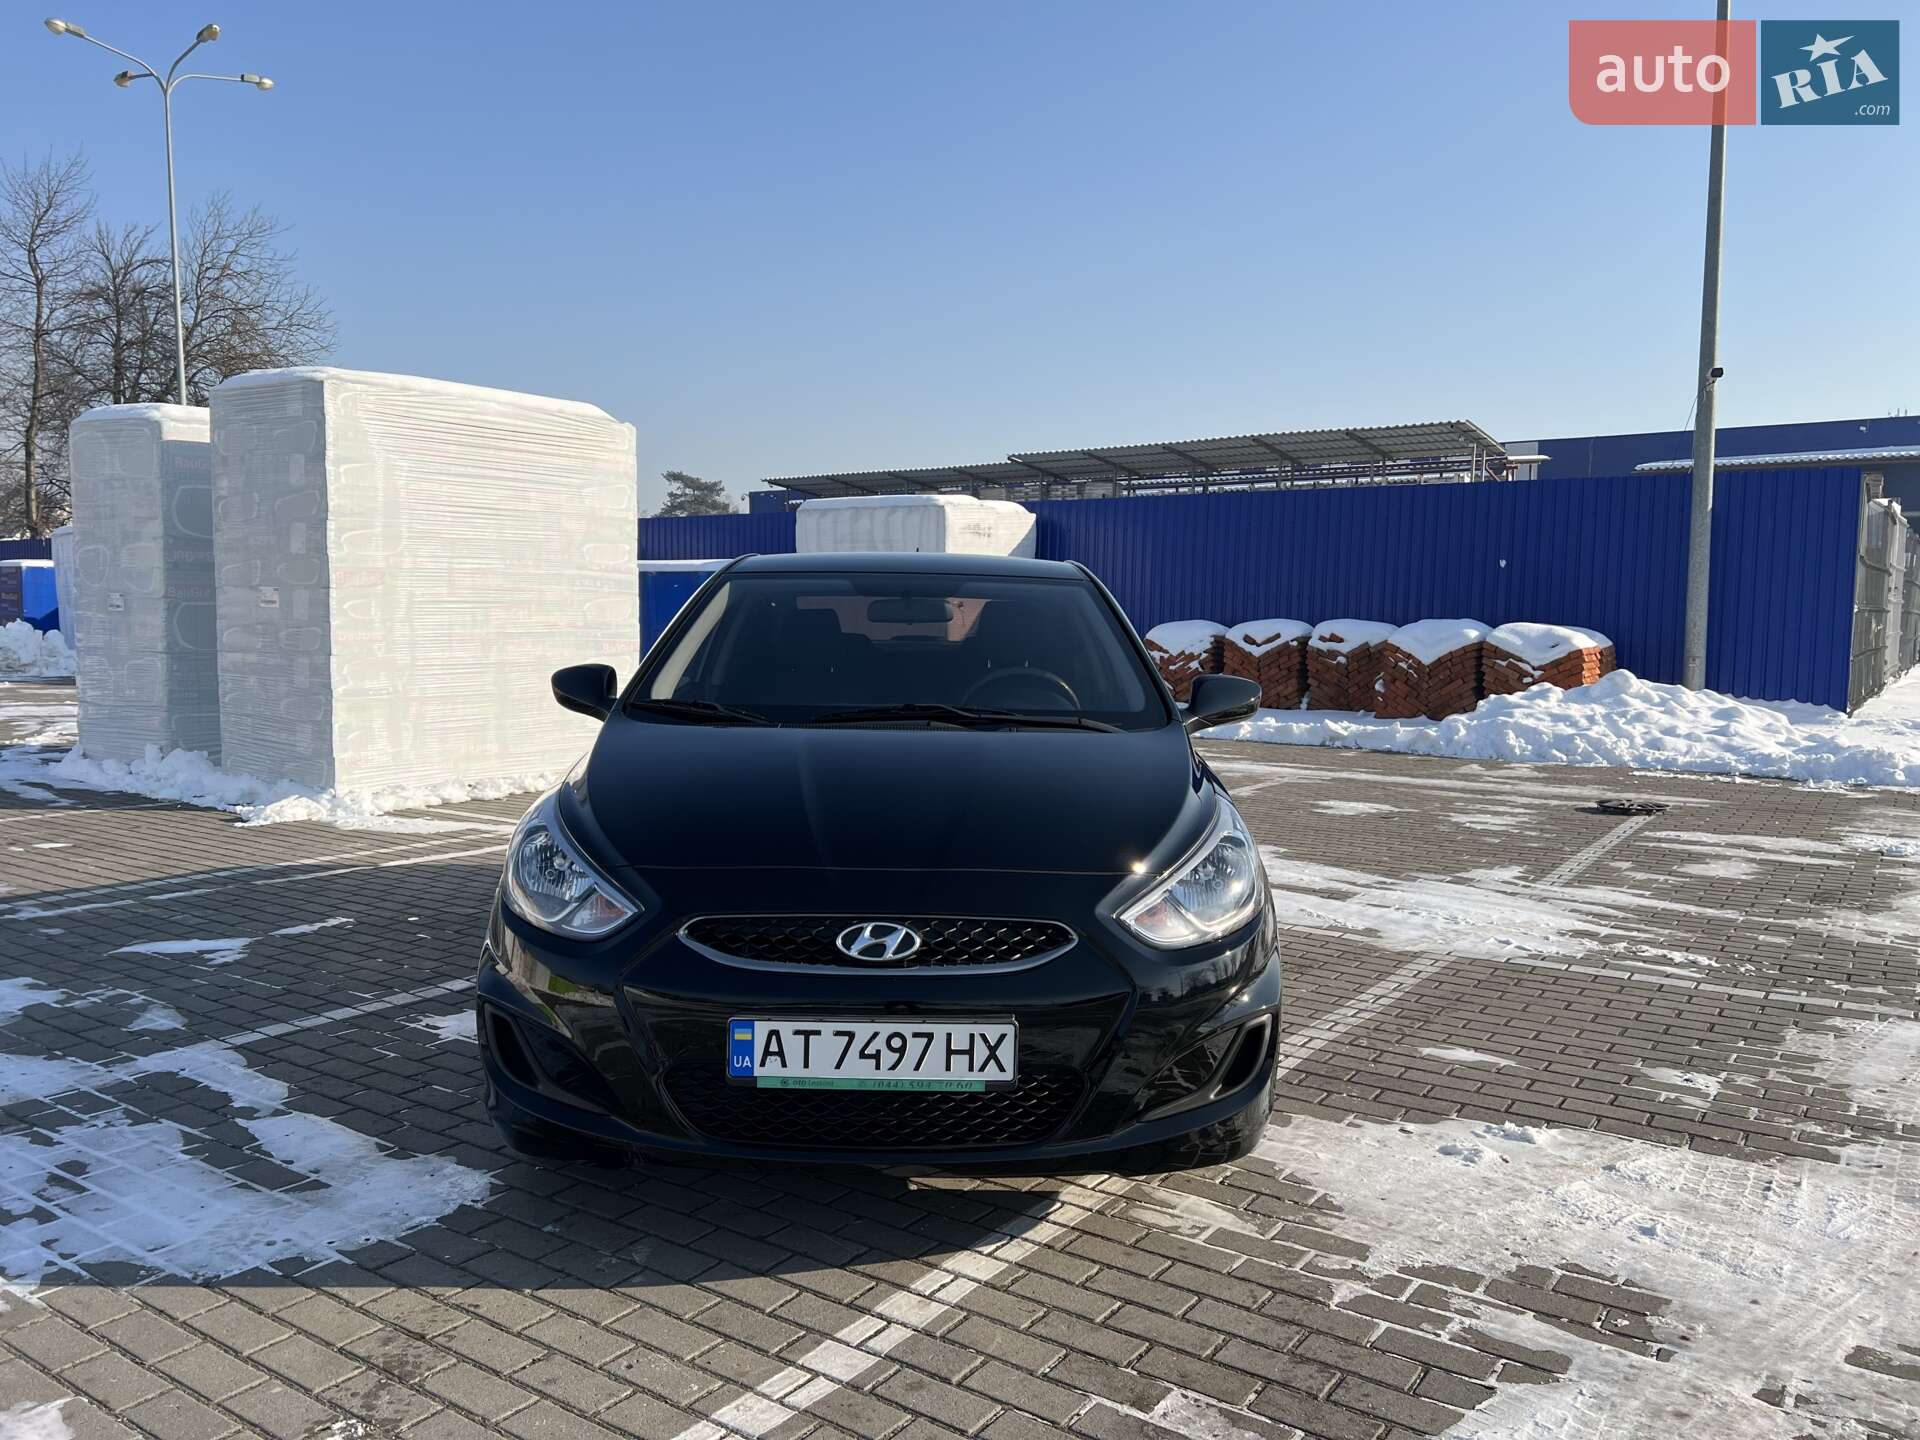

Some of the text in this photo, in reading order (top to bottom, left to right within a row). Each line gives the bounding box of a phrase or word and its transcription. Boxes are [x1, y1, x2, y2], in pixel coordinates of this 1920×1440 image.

[733, 1056, 752, 1068] UA
[759, 1029, 1009, 1073] AT 7497 HX
